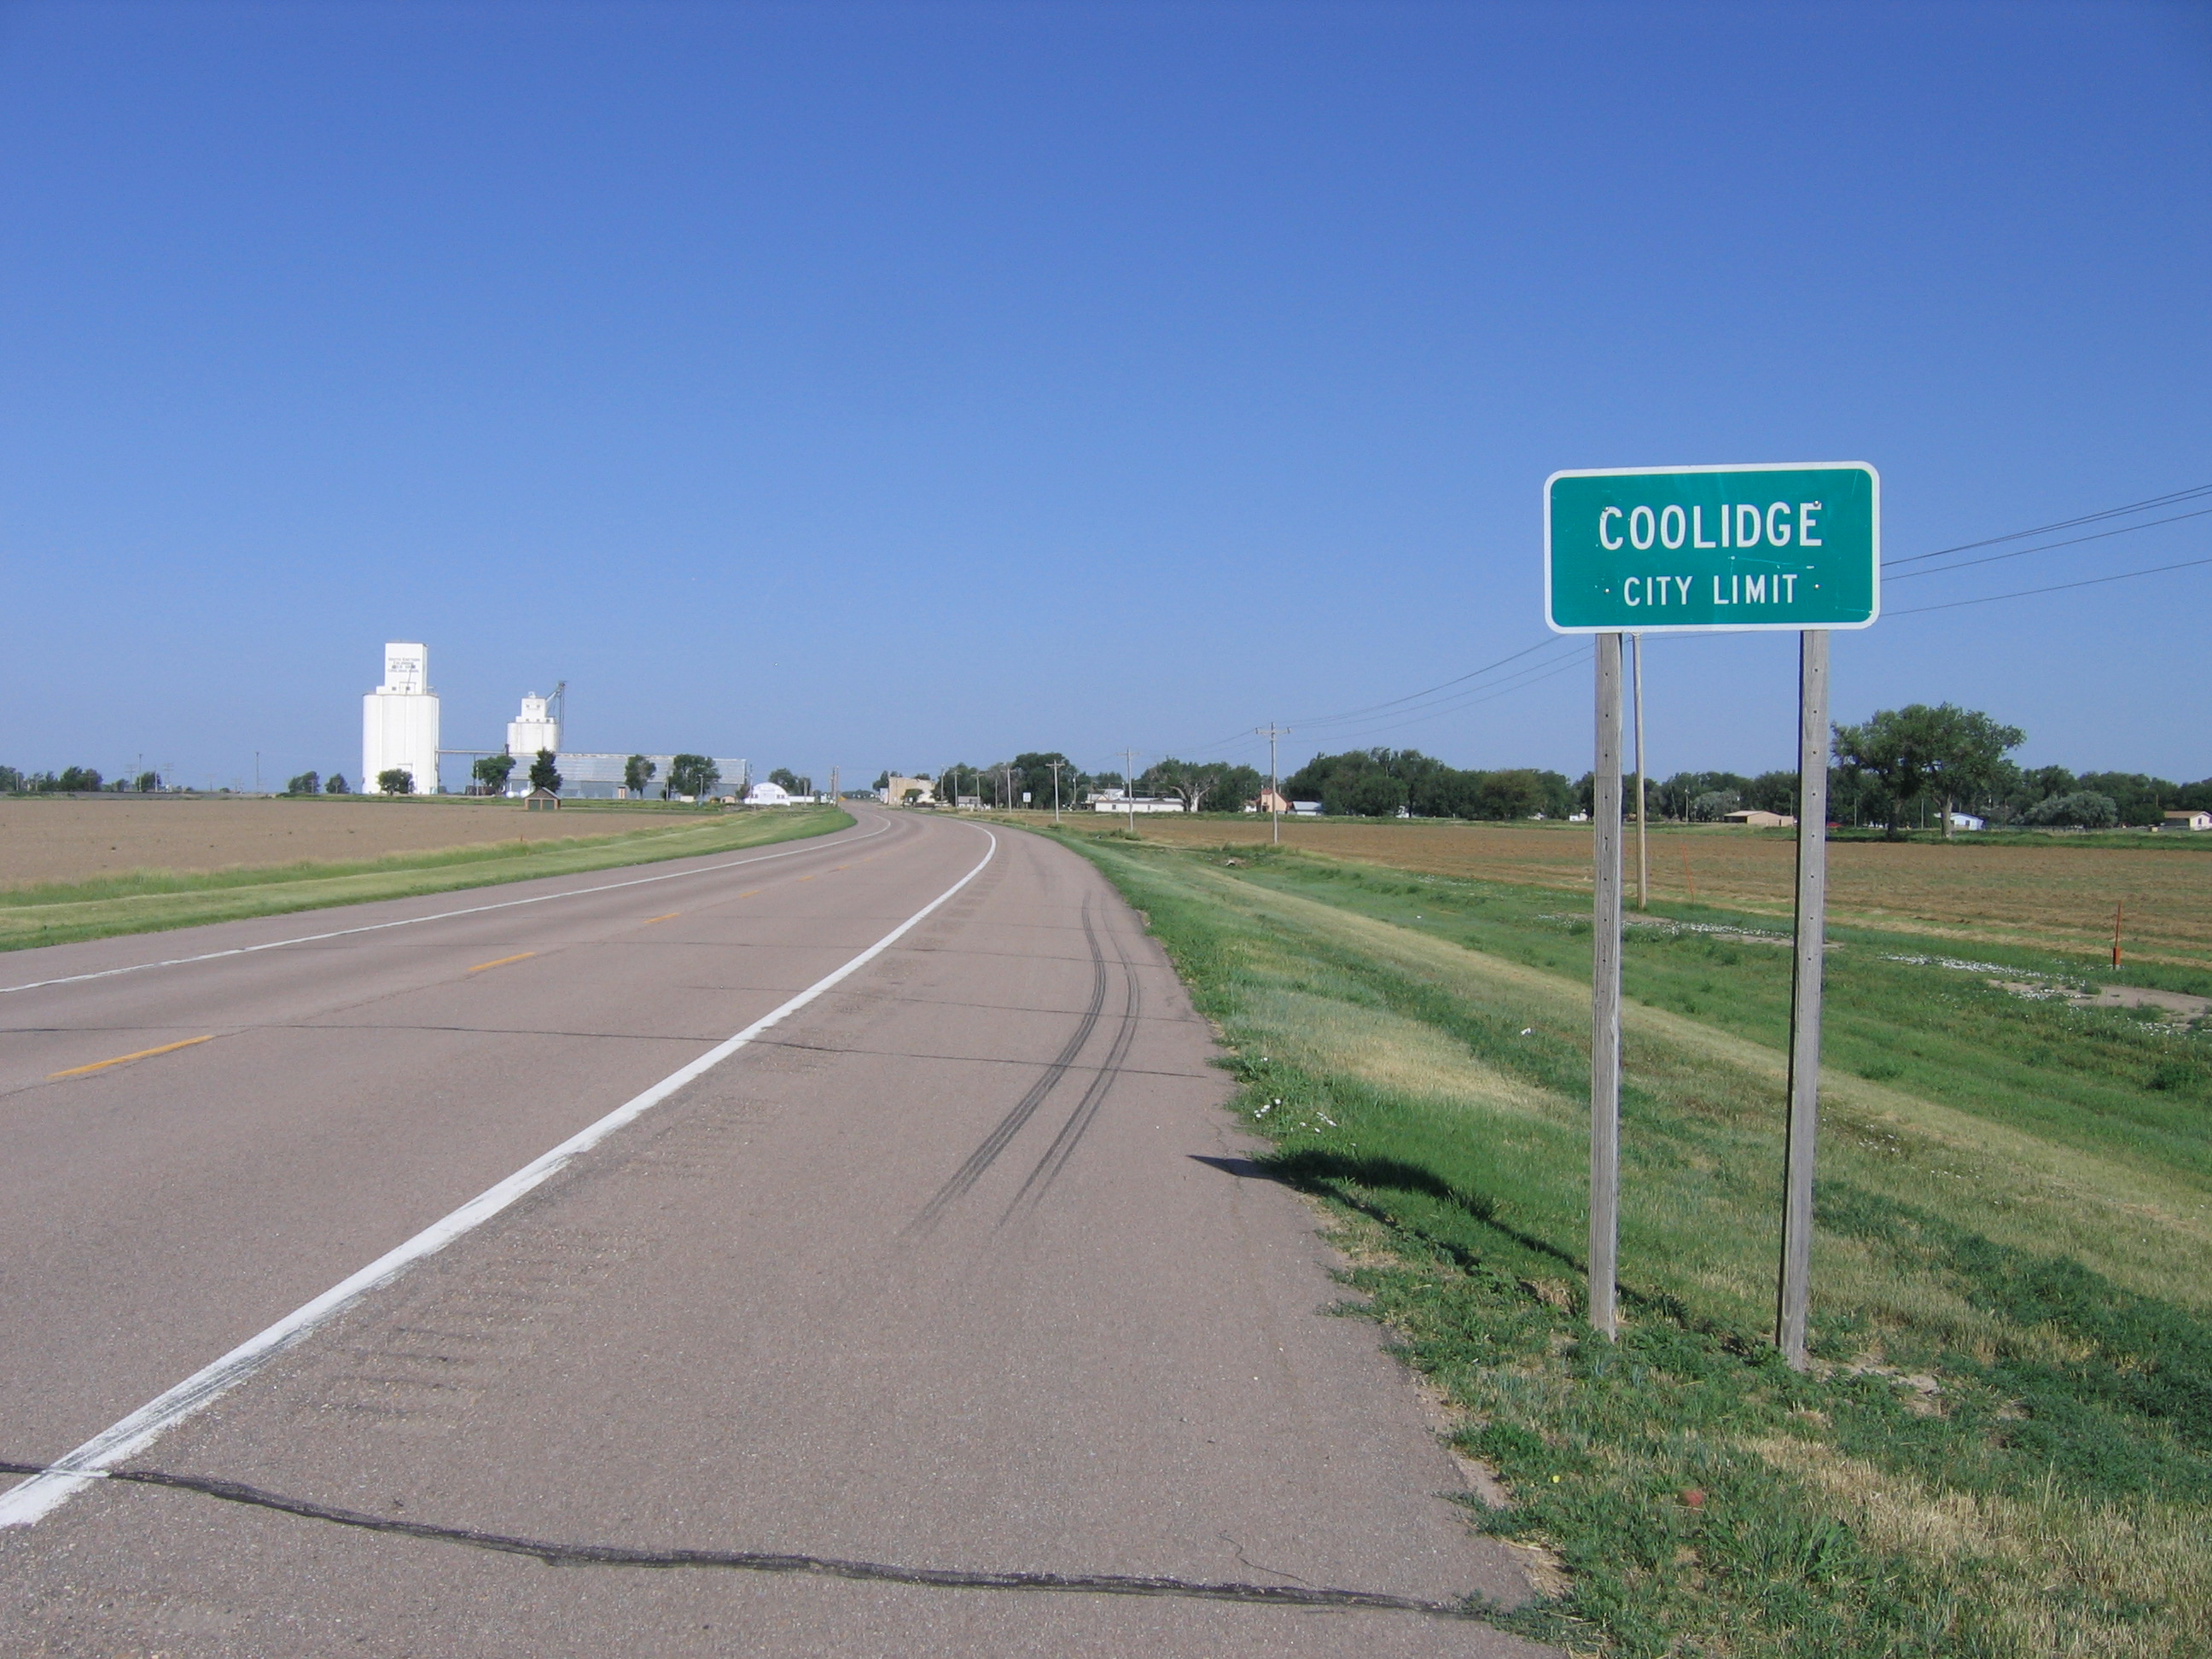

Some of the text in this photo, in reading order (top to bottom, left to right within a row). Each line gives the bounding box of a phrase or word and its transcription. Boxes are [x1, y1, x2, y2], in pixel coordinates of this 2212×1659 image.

[1598, 501, 1822, 550] COOLIDGE
[1623, 573, 1798, 607] CITY LIMIT
